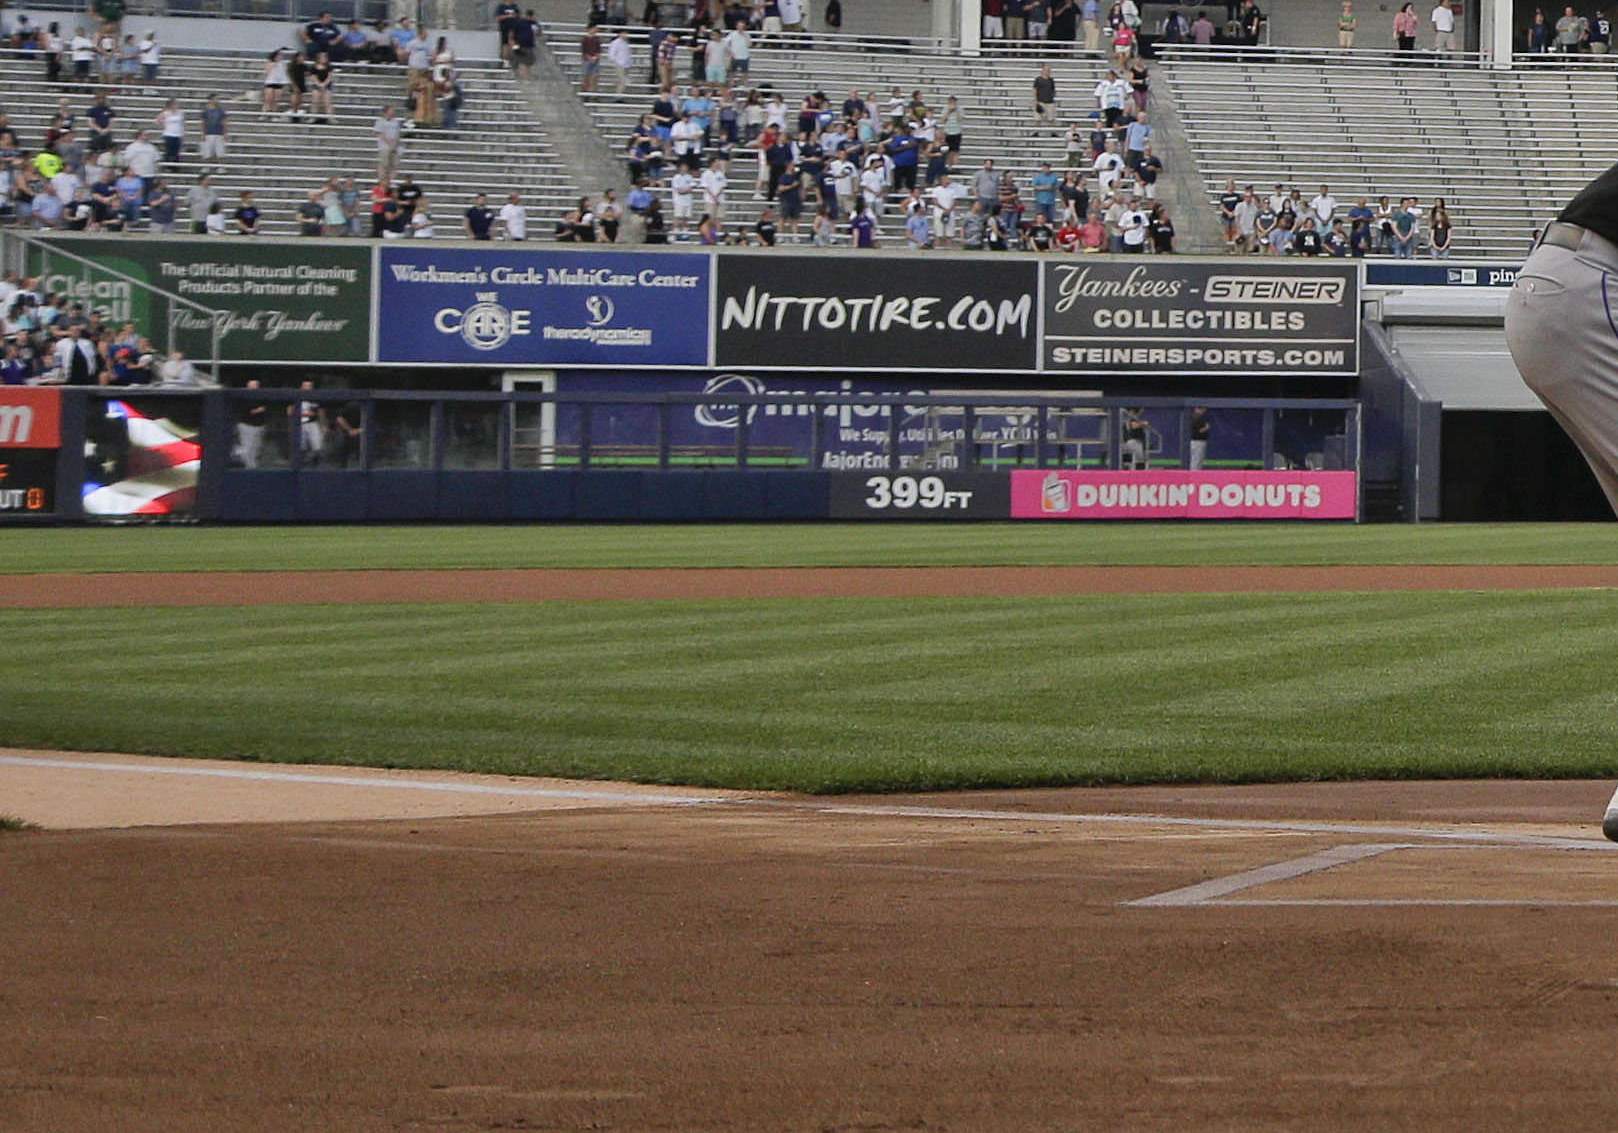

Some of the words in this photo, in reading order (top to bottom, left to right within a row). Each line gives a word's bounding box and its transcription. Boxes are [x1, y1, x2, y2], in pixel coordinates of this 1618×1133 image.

[391, 264, 488, 284] Workmen's
[490, 267, 543, 285] Circle
[546, 268, 636, 287] MultiCare
[638, 269, 698, 288] Center
[475, 292, 498, 302] WE
[1054, 265, 1182, 313] Yankees
[1208, 279, 1340, 299] STEINER
[722, 284, 1032, 340] NITTOTIRE.COM
[1093, 309, 1305, 330] COLLECTIBLES
[1053, 347, 1344, 365] STEINERSPORTS.COM
[1076, 482, 1195, 508] DUNKIN'
[1197, 482, 1321, 508] DONUTS
